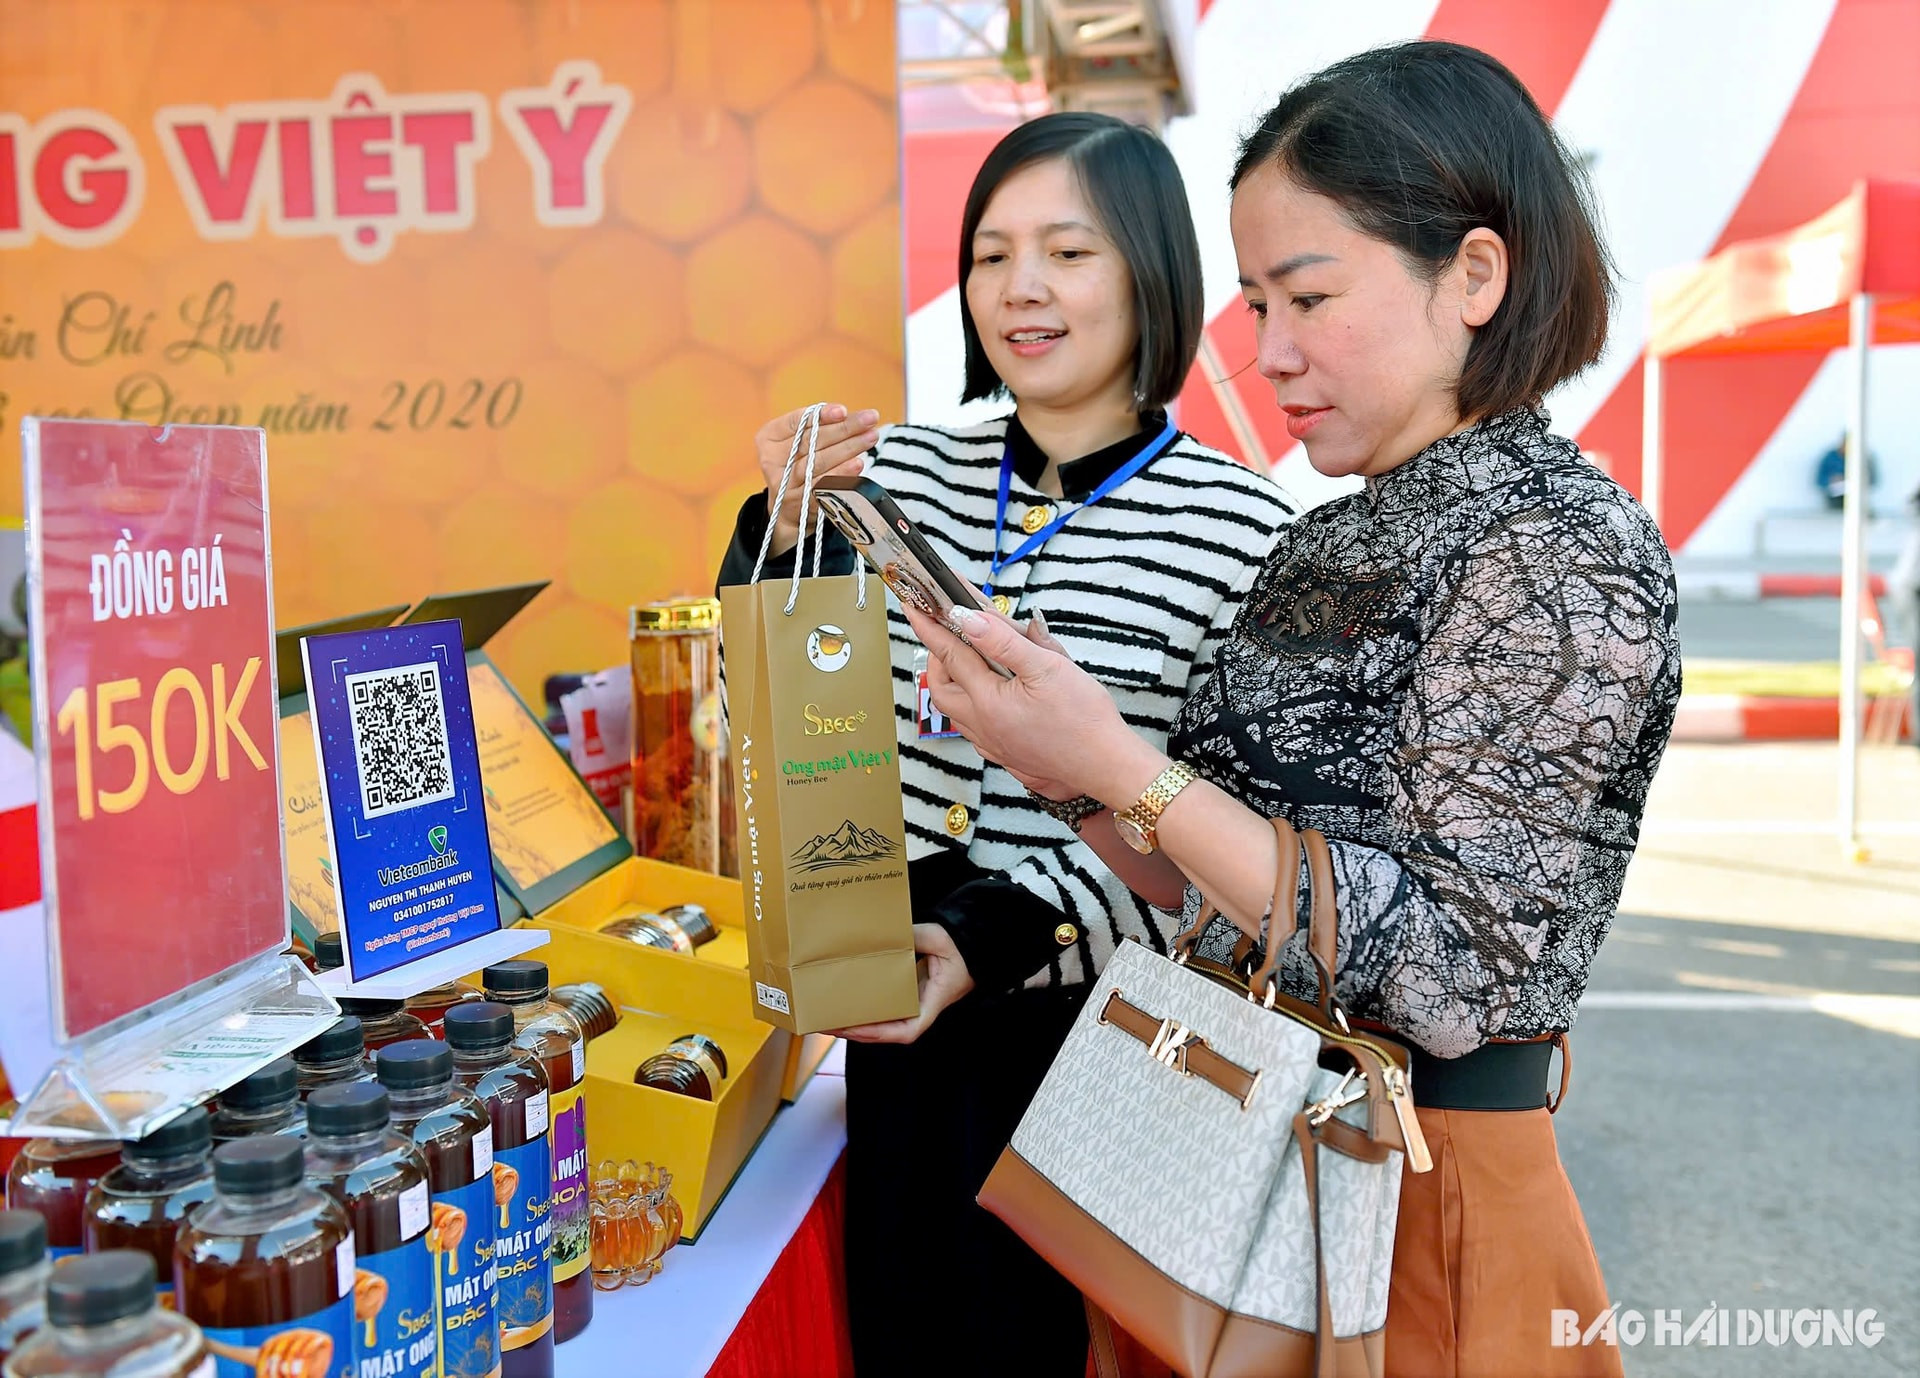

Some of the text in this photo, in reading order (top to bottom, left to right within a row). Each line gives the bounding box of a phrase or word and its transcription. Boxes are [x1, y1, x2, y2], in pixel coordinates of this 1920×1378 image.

[0, 68, 622, 255] G VIỆT Ý
[259, 391, 349, 433] năm
[372, 377, 524, 431] 2020
[89, 528, 228, 622] ĐỒNG GIÁ
[57, 656, 270, 821] 150K
[782, 759, 816, 777] Ong
[817, 756, 848, 774] mật
[787, 775, 829, 786] Honey Bee
[378, 848, 458, 887] Vietcombank
[841, 876, 854, 887] giá
[864, 872, 882, 882] thiên
[882, 870, 904, 880] nhiên
[369, 871, 473, 912] NGUYEN THI THANH HUYEN
[393, 894, 454, 922] 0341001752817
[753, 870, 763, 921] Ong
[557, 1148, 585, 1180] MẬT
[497, 1230, 532, 1258] MẬT
[445, 1259, 498, 1308] MẬT ON
[497, 1255, 538, 1279] ĐẶC
[446, 1302, 487, 1330] ĐẶC
